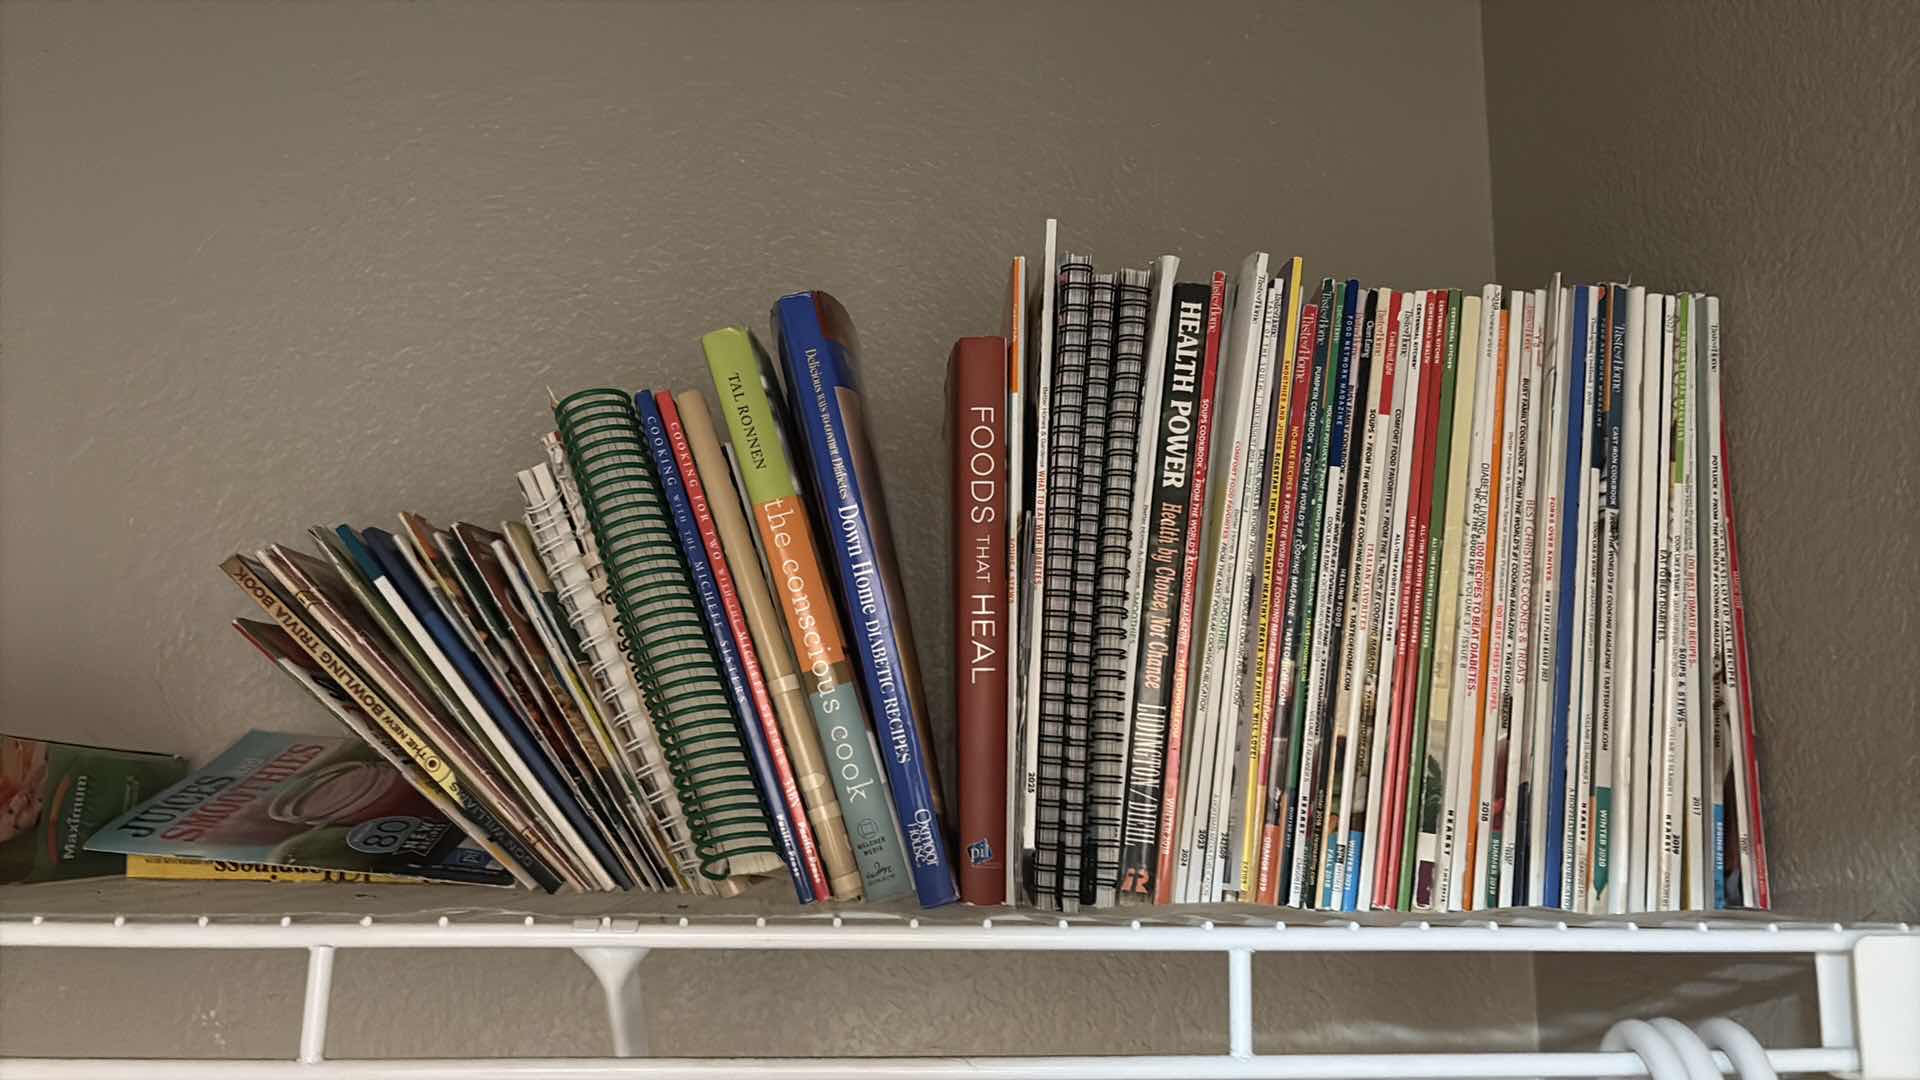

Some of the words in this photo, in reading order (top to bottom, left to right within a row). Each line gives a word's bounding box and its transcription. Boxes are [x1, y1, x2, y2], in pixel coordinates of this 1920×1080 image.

[1344, 314, 1353, 337] FOOD
[1413, 303, 1422, 339] CENTENNIAL
[1425, 302, 1434, 338] CENTENNIAL
[1436, 299, 1444, 336] CENTENNIAL
[1448, 307, 1456, 342] CENTENNIAL
[1171, 300, 1202, 393] HEALTH
[1340, 340, 1350, 379] NETWORK
[1410, 342, 1418, 369] KITCHEN
[1433, 338, 1441, 363] KITCHEN
[1279, 359, 1290, 401] SMOOTHIES
[727, 372, 741, 403] TAL
[738, 404, 767, 470] RONNEN
[1277, 405, 1286, 420] AND
[1336, 382, 1346, 425] MAGAZINE
[1367, 409, 1376, 433] SOUPS
[803, 347, 821, 393] Delicious
[831, 456, 847, 500] Diabetes
[1275, 423, 1284, 450] JUICES
[1391, 408, 1402, 444] COMFORT
[1162, 399, 1192, 488] POWER
[1364, 442, 1373, 463] FROM
[1389, 445, 1397, 466] FOOD
[1517, 425, 1525, 467] COOKBOOK
[970, 407, 995, 523] FOODS
[1037, 470, 1045, 492] WHAT
[1270, 452, 1281, 494] KICKSTART
[670, 421, 698, 489] COOKING
[693, 493, 710, 523] FOR
[704, 528, 722, 561] TWO
[1036, 495, 1044, 505] TO
[1360, 481, 1369, 513] WORLD'S
[1384, 467, 1395, 507] FAVORITES
[1479, 462, 1490, 506] DIABETIC
[1515, 476, 1523, 497] FROM
[1609, 465, 1617, 505] COOKBOOK
[1035, 507, 1044, 521] EAT
[1267, 514, 1275, 530] DAY
[1269, 497, 1277, 512] THE
[1477, 508, 1487, 535] LIVING
[1525, 499, 1535, 522] BEST
[1034, 523, 1043, 545] WITH
[1158, 502, 1182, 545] Health
[1380, 515, 1389, 537] FROM
[1512, 516, 1520, 550] WORLD'S
[646, 415, 678, 487] COOKING
[683, 530, 697, 553] THE
[719, 639, 747, 704] SISTERS
[975, 535, 991, 582] THAT
[1151, 546, 1178, 563] by
[1265, 532, 1274, 552] WITH
[1355, 527, 1365, 561] COOKING
[1379, 539, 1387, 553] THE
[1476, 541, 1485, 557] 100
[1521, 526, 1534, 583] CHRISTMAS
[1033, 547, 1042, 584] DIABETES
[1263, 555, 1272, 579] TASTY
[1364, 543, 1374, 579] ITALIAN
[1607, 552, 1615, 582] WORLD'S
[1658, 566, 1666, 576] TO
[231, 565, 277, 609] BOOK
[1147, 565, 1176, 612] Choice,
[1337, 568, 1346, 599] HEALING
[1351, 563, 1362, 603] MAGAZINE
[1473, 559, 1484, 599] RECIPES
[1509, 562, 1517, 597] COOKING
[1259, 583, 1269, 618] HEALTHY
[1334, 601, 1342, 627] FOODS
[1358, 581, 1370, 631] FAVORITES
[1472, 600, 1481, 613] TO
[1518, 586, 1530, 631] COOKIES
[1605, 595, 1613, 628] COOKING
[1688, 595, 1696, 628] TOMATO
[271, 605, 321, 653] TRIVIA
[837, 503, 863, 557] Down
[850, 560, 877, 615] Home
[865, 619, 895, 695] DIABETIC
[883, 696, 911, 765] RECIPES
[1148, 614, 1172, 639] Not
[1256, 622, 1266, 652] TREATS
[1470, 615, 1480, 640] BEAT
[1506, 599, 1515, 640] MAGAZINE
[1656, 600, 1665, 640] DIABETES
[763, 497, 795, 549] the
[781, 557, 840, 713] conscious
[831, 725, 875, 804] cook
[970, 594, 996, 685] HEAL
[1342, 614, 1357, 691] TASTEOFHOME.COM
[1517, 635, 1527, 643] &
[1688, 631, 1696, 663] RECIPES
[1143, 640, 1169, 690] Chance
[1254, 655, 1263, 677] YOUR
[1466, 642, 1478, 690] DIABETES
[1514, 647, 1526, 684] TREATS
[1679, 648, 1687, 677] SOUPS
[315, 649, 388, 718] BOWLING
[1251, 680, 1260, 709] FAMILY
[1252, 712, 1260, 731] WILL
[1600, 675, 1610, 750] TASTEOFHOME.COM
[1678, 691, 1686, 722] STEWS
[381, 713, 408, 740] NEW
[402, 734, 429, 760] THE
[1129, 703, 1166, 787] LUDINGTON
[1249, 735, 1258, 760] LOVE!
[1027, 772, 1035, 793] 2025
[63, 775, 88, 860] Maximum
[1123, 801, 1156, 847] DIEHL
[1298, 795, 1307, 834] HEARST
[1480, 801, 1489, 821] 2018
[775, 813, 794, 850] Pacific
[787, 850, 801, 878] Press
[914, 808, 939, 866] Oxmoor
[1444, 809, 1453, 855] HEARST
[797, 821, 814, 858] Pacific
[808, 858, 822, 885] Press
